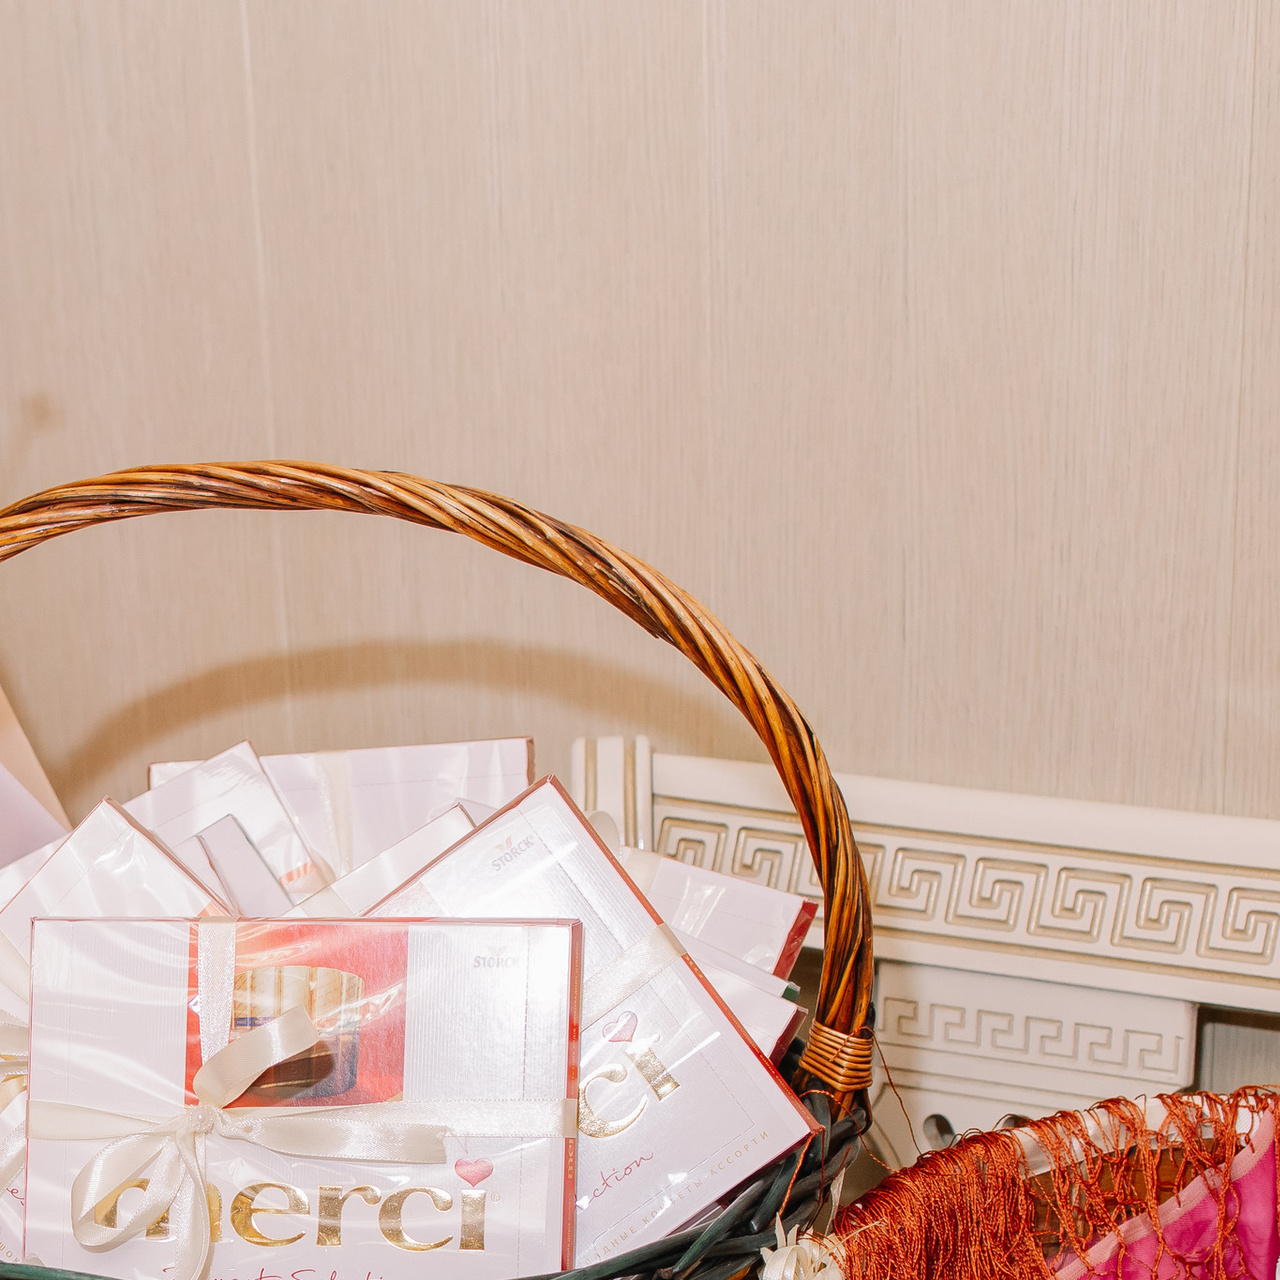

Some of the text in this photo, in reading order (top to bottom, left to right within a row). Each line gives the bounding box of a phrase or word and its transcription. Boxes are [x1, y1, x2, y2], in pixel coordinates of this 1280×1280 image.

[491, 836, 535, 872] STORCK
[709, 1130, 770, 1176] АССОРТИ
[588, 1153, 654, 1205] ction
